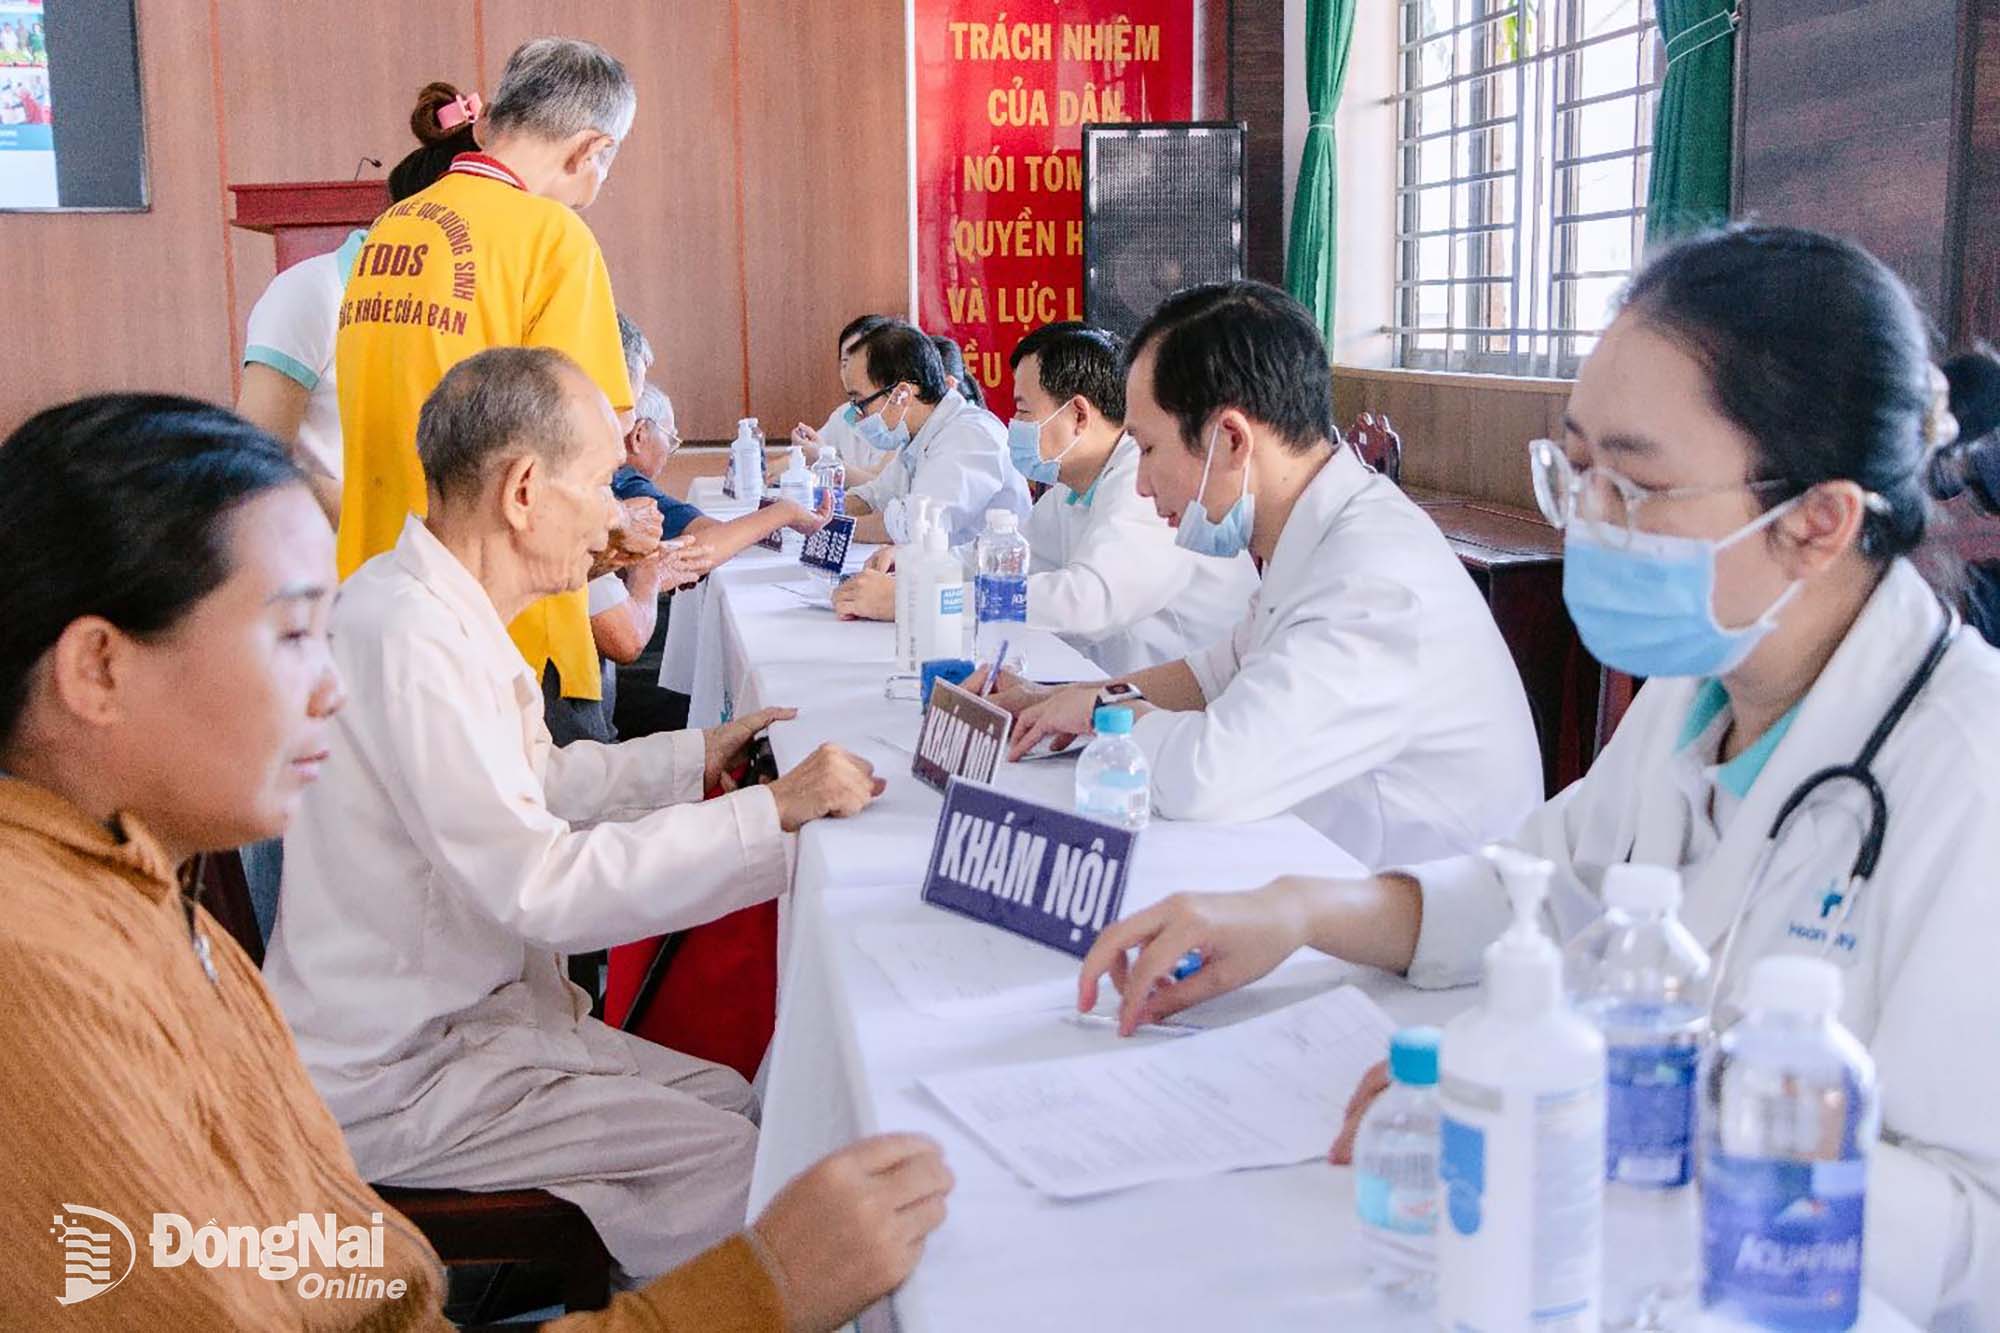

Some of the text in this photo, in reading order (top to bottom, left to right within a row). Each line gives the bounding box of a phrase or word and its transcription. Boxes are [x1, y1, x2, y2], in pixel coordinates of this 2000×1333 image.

[949, 12, 1160, 68] TRÁCH NHIỆM
[987, 75, 1050, 127] CỦA
[963, 145, 1015, 193] NÓI
[358, 243, 429, 277] TDDS
[954, 206, 1056, 264] QUYỀN
[452, 261, 476, 301] SINH
[947, 277, 987, 324] VÀ
[998, 280, 1057, 332] LỰC
[354, 292, 394, 324] KHỎE
[395, 292, 423, 326] CỦA
[427, 303, 468, 336] BẠN
[962, 337, 1002, 388] ỀU
[920, 704, 971, 776] KHÁM
[938, 810, 1119, 943] KHÁM NỘI
